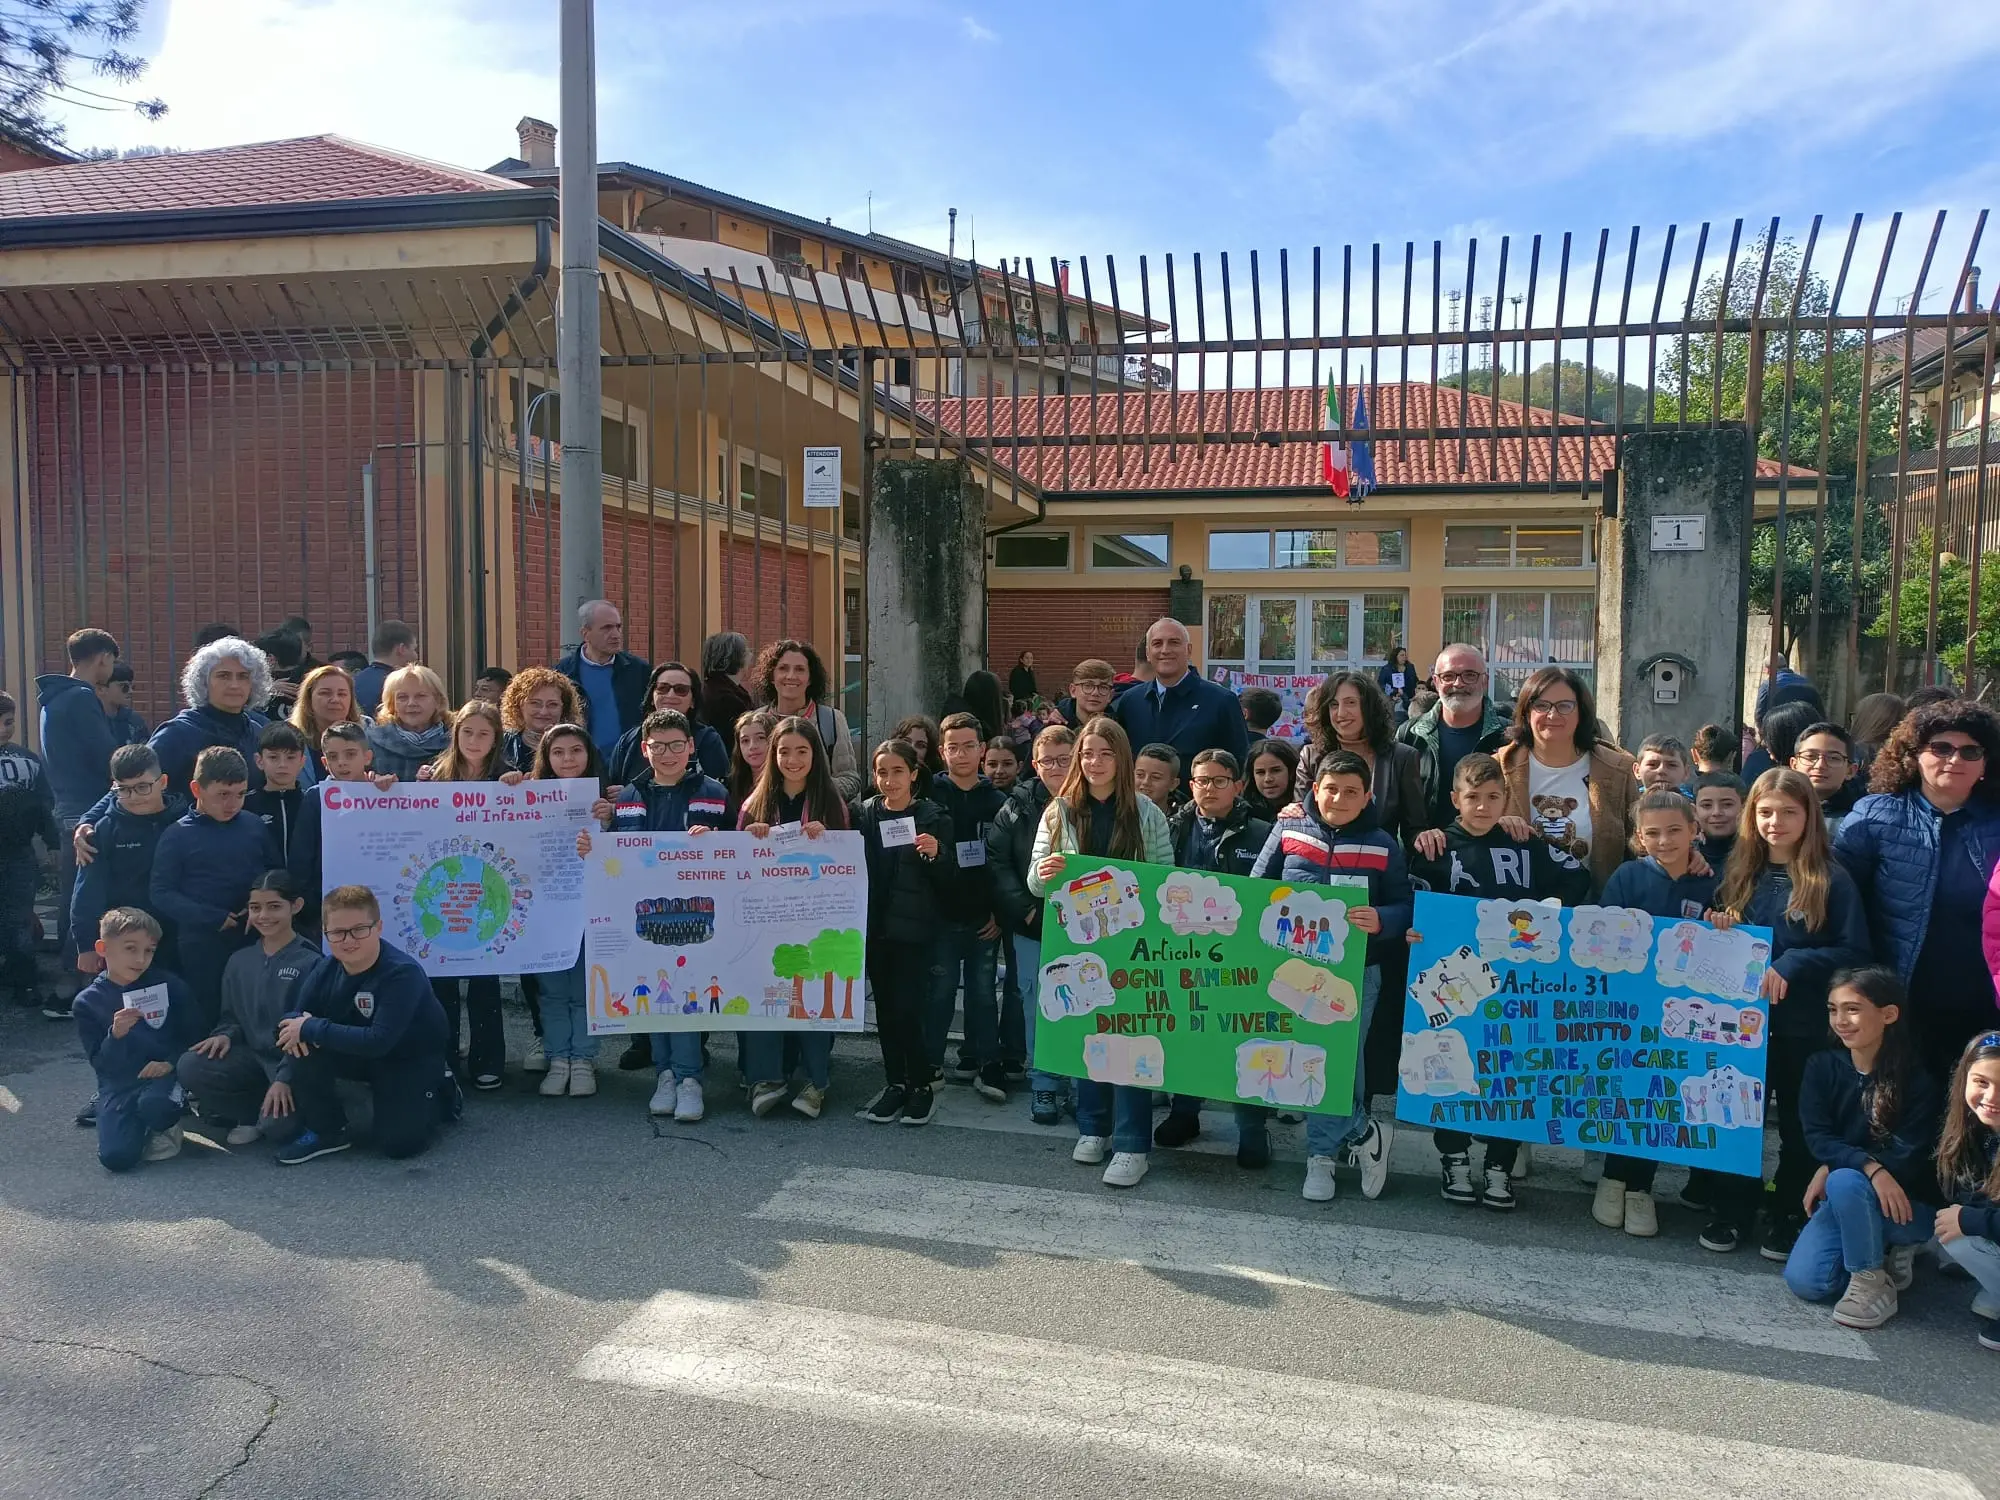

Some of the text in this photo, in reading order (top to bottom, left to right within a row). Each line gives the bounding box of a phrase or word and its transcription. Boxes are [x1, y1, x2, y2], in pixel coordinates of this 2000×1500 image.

[1673, 524, 1682, 540] 1
[1241, 673, 1269, 687] DIRITTI
[1273, 675, 1287, 688] DEI
[324, 786, 568, 810] Convenzione ONU sui Diritti
[616, 837, 653, 848] FUORI
[658, 850, 704, 861] CLASSE
[713, 849, 736, 860] PER
[677, 865, 857, 881] SENTIRE LA NOSTRA VOCE!
[1129, 938, 1224, 963] Articolo 6
[1110, 967, 1259, 990] OGNI BAMBINO
[1500, 969, 1609, 996] Articolo 31
[1145, 990, 1209, 1012] HA IL
[1483, 999, 1640, 1020] OGNI BAMBINO
[1096, 1012, 1293, 1033] DIRITTO DI VIVERE
[1483, 1021, 1660, 1048] HA IL DIRITTO DI
[1477, 1047, 1718, 1075] RIPOSARE, GIOCARE E
[1478, 1074, 1678, 1099] PARTECIPARE AD
[1551, 1098, 1682, 1124] RICREATIVE
[1546, 1120, 1717, 1150] E CULTURALI
